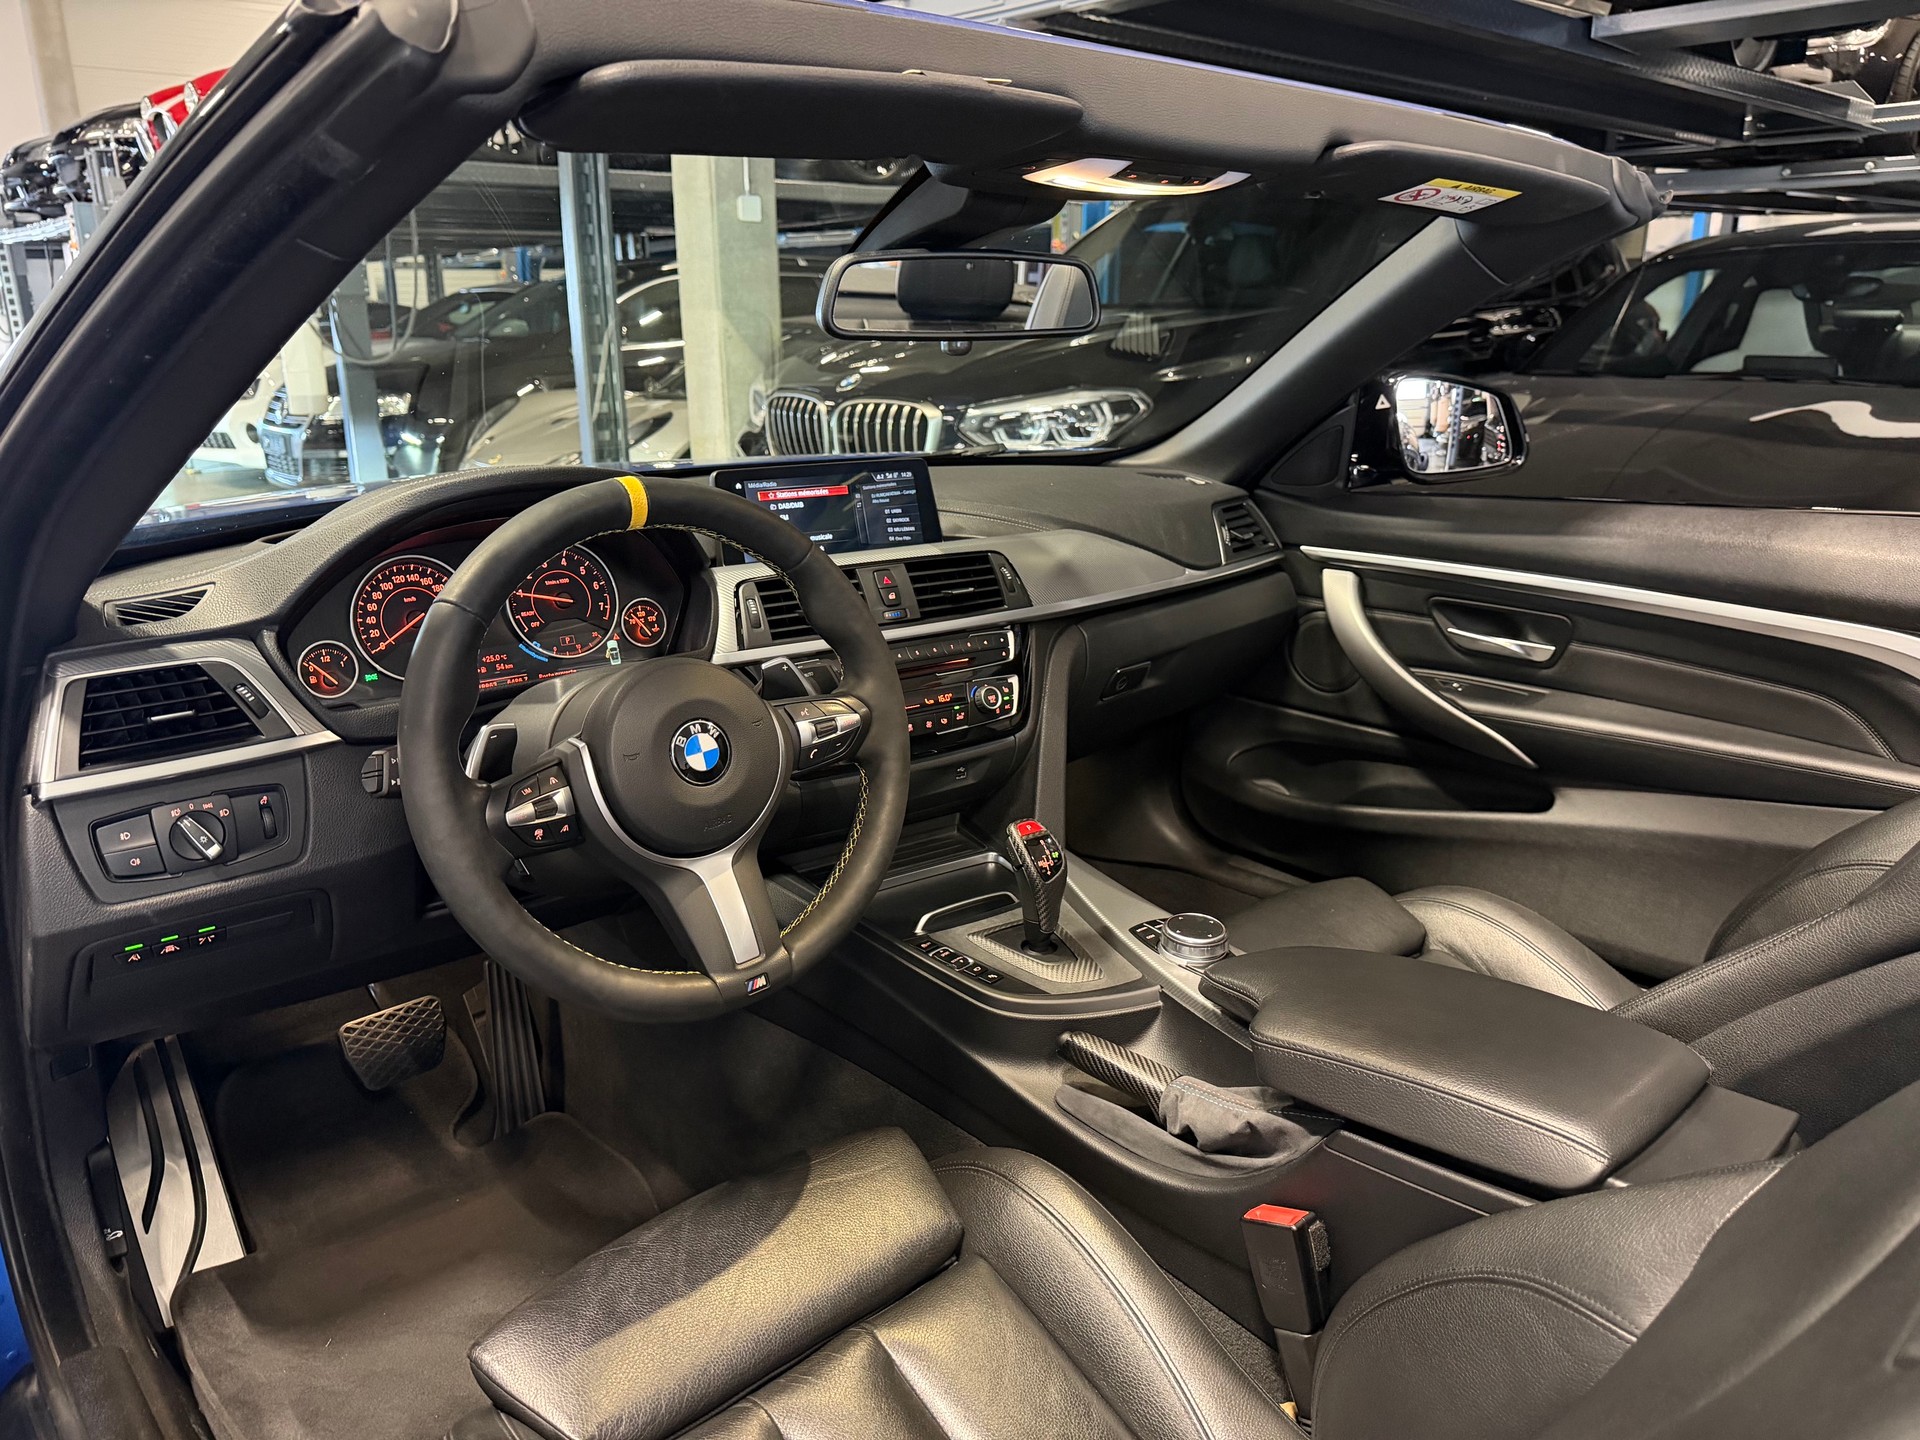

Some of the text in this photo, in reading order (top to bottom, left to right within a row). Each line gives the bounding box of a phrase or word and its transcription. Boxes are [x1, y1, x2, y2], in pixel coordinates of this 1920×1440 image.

[798, 489, 829, 497] mémorisées
[561, 558, 567, 566] 4
[580, 567, 586, 575] 5
[392, 575, 405, 584] 120
[406, 573, 419, 582] 140
[420, 577, 433, 586] 160
[379, 582, 393, 591] 100
[432, 583, 445, 593] 180
[593, 582, 599, 590] 6
[372, 592, 382, 600] 80
[367, 603, 377, 611] 60
[599, 602, 604, 610] 7
[366, 616, 376, 624] 40
[369, 629, 380, 637] 20
[320, 655, 331, 663] 1/2
[482, 655, 500, 663] +25.0
[676, 723, 719, 747] BMW
[521, 787, 532, 795] LIM
